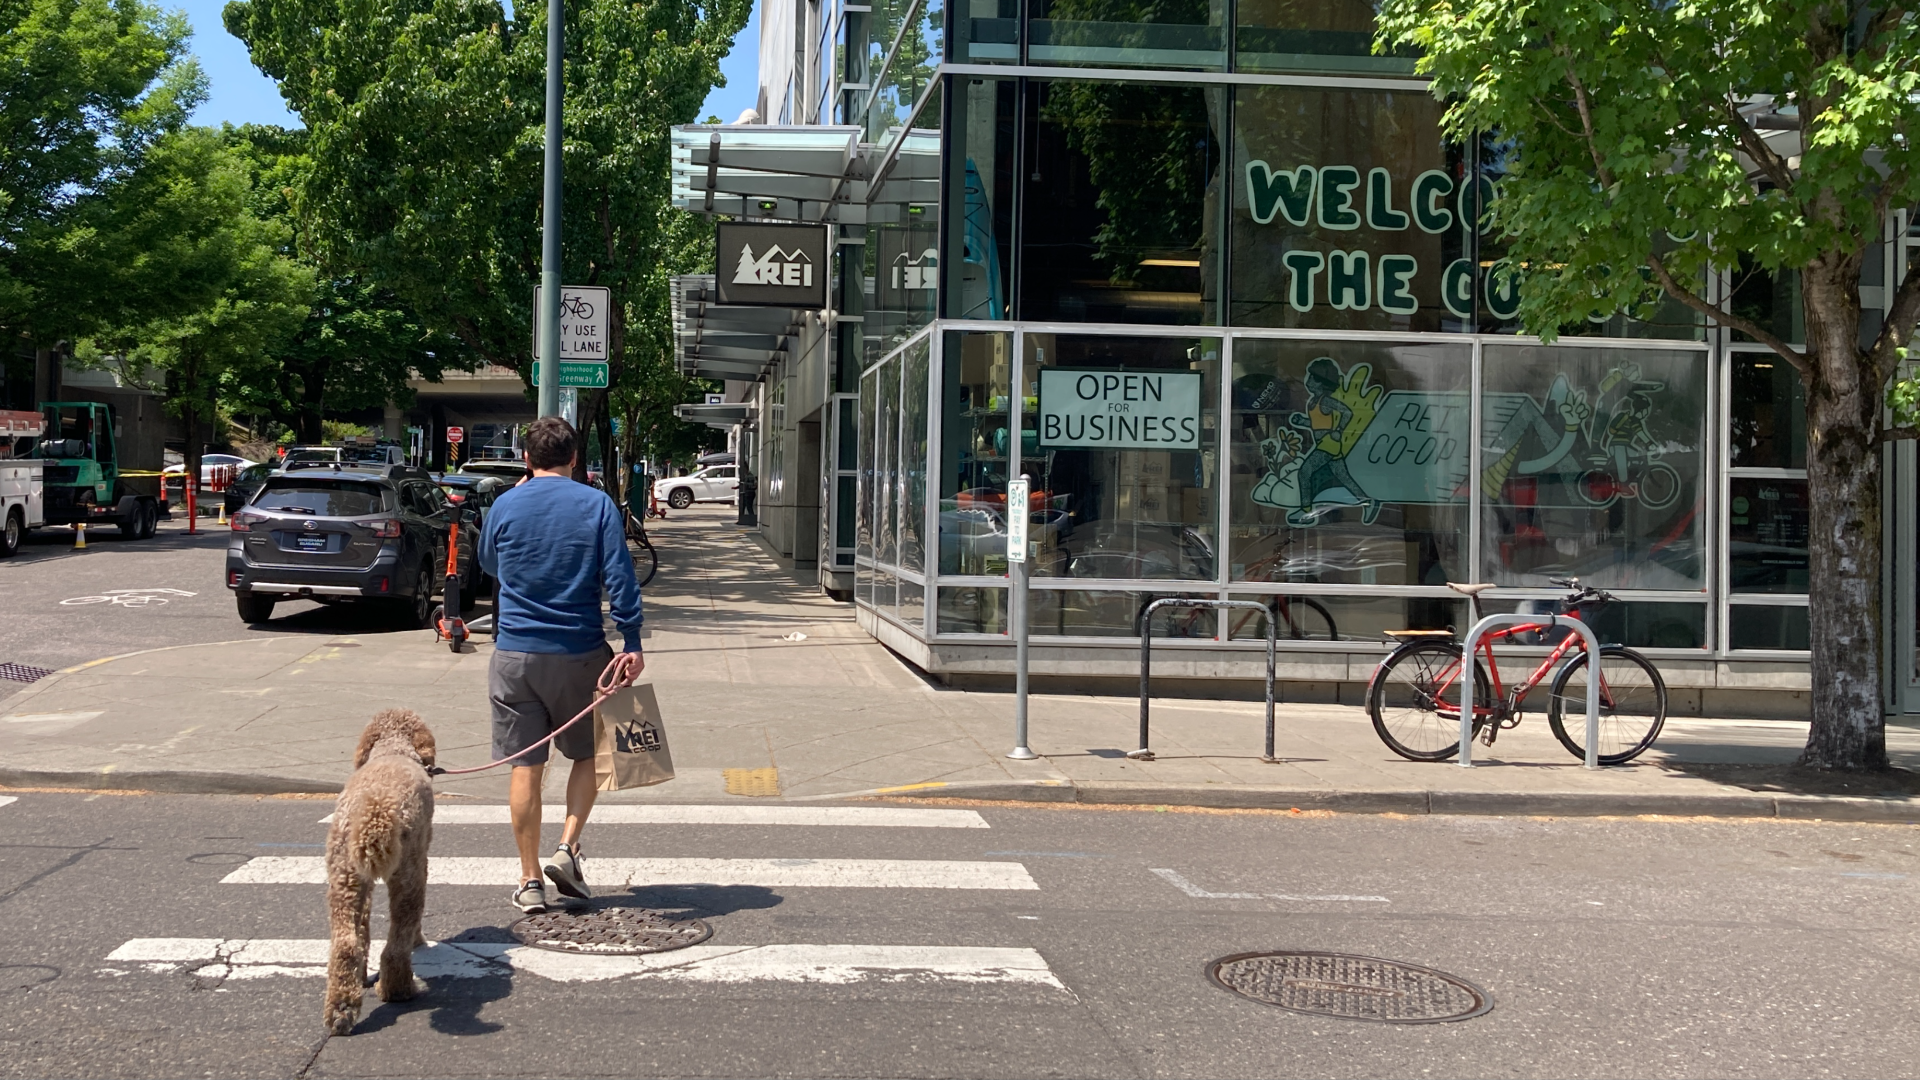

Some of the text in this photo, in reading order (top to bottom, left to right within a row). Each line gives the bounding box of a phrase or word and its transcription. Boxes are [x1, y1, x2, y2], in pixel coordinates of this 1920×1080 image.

[759, 262, 812, 287] REI
[1282, 250, 1419, 315] THE
[575, 325, 597, 336] USE
[574, 341, 602, 353] LANE
[1076, 374, 1162, 401] OPEN
[1108, 403, 1130, 413] FOR
[1394, 403, 1460, 434] REI
[1045, 414, 1195, 443] BUSINESS
[1368, 433, 1457, 465] CO-OP
[631, 729, 659, 747] REI
